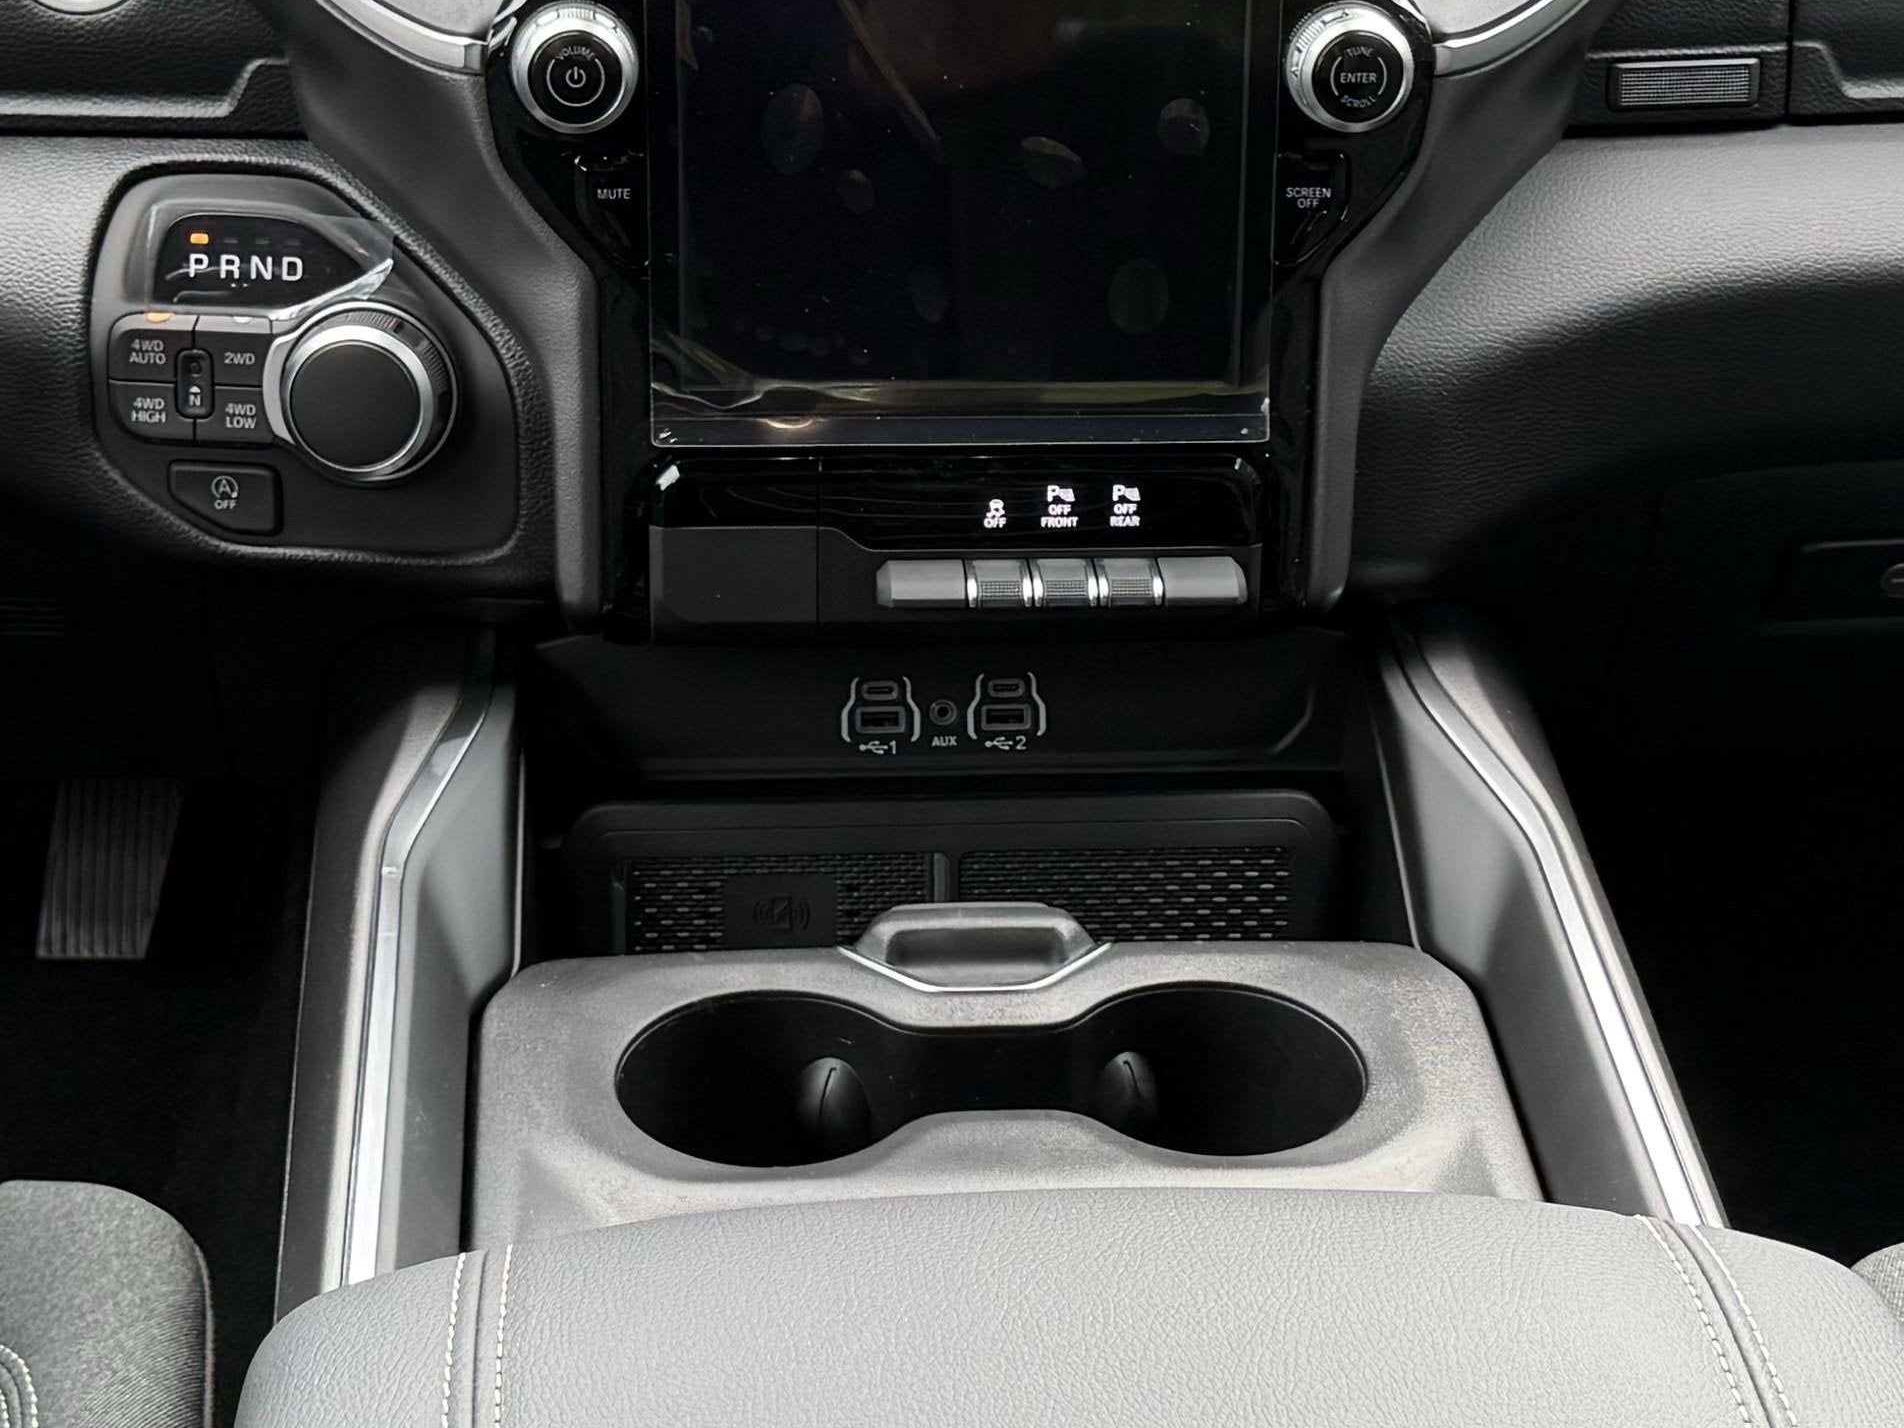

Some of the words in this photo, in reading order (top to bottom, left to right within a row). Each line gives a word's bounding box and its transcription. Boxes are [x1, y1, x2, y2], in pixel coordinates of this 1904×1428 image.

[556, 46, 596, 61] VOLUME
[1346, 46, 1374, 58] TUNE
[1340, 73, 1377, 84] ENTER
[1340, 95, 1377, 108] SCROLL
[597, 188, 631, 200] MUTE
[1286, 187, 1331, 199] SCREEN
[1297, 198, 1319, 209] OFF
[131, 339, 163, 352] 4WD
[129, 351, 166, 365] AUTO
[224, 352, 255, 366] 2WD
[133, 398, 164, 410] 4WD
[189, 394, 202, 407] N
[225, 403, 256, 417] 4WD
[132, 410, 166, 424] HIGH
[226, 416, 256, 429] LOW
[214, 499, 237, 510] OFF
[1048, 504, 1072, 515] OFF
[1113, 503, 1137, 515] OFF
[983, 517, 1007, 528] OFF
[1040, 516, 1078, 528] FRONT
[1110, 516, 1140, 527] REAR
[888, 740, 897, 755] 1
[931, 736, 958, 747] AUX
[1015, 735, 1028, 750] 2
